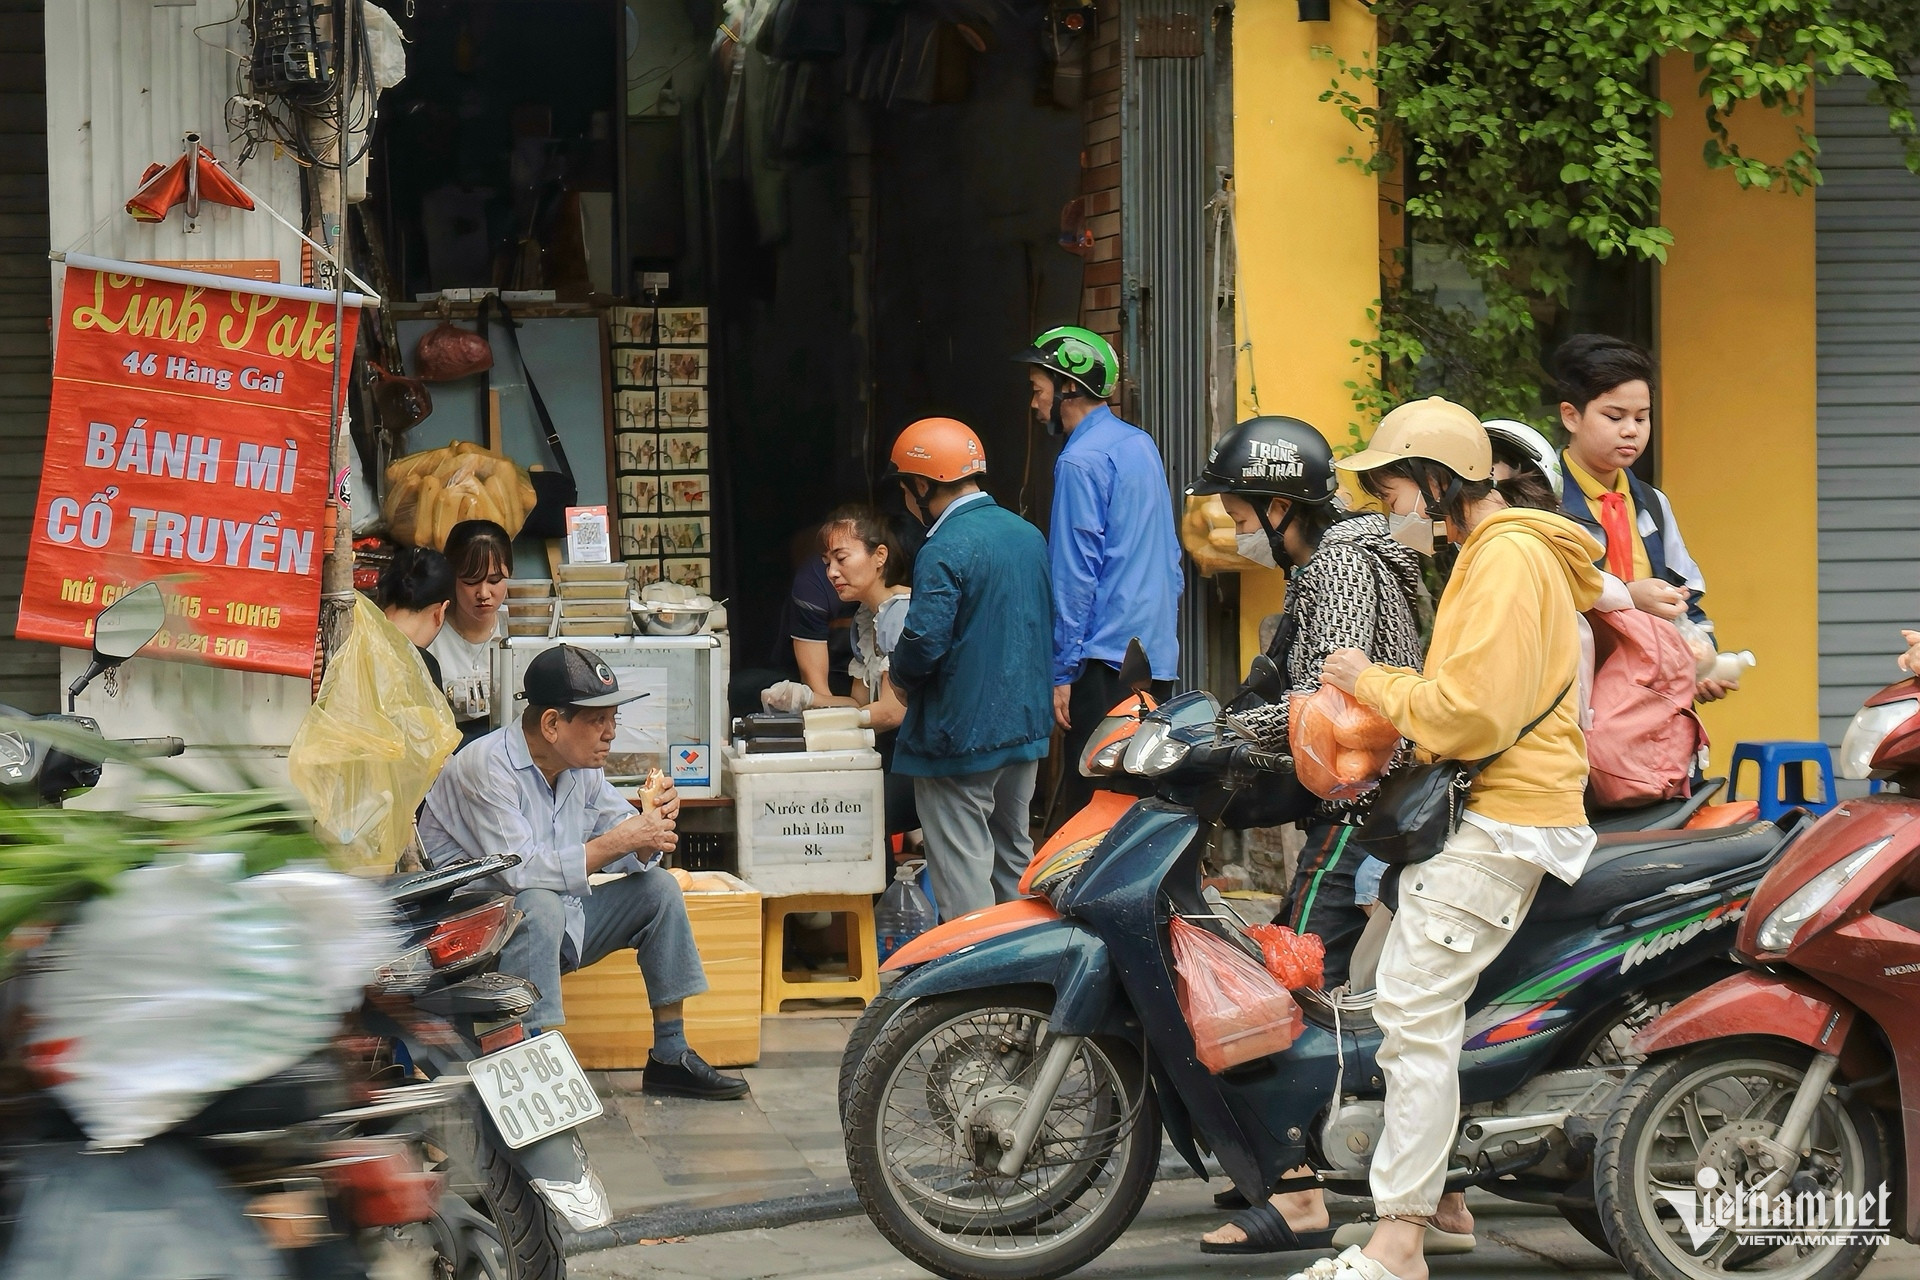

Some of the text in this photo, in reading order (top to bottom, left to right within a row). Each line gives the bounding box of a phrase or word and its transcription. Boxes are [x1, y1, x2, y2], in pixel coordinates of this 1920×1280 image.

[122, 350, 285, 394] 46 Hàng Gai
[84, 418, 298, 494] BÁNH MÌ
[46, 486, 315, 575] CỔ TRUYỀN
[61, 575, 97, 605] MỞ
[226, 602, 281, 629] 10H15
[176, 632, 208, 654] 221
[214, 637, 248, 659] 510
[764, 798, 861, 816] Nước đỗ đen
[783, 822, 844, 835] nhà làm
[804, 844, 822, 856] 8k
[486, 1043, 564, 1099] 29-BG
[499, 1078, 592, 1140] 019.58
